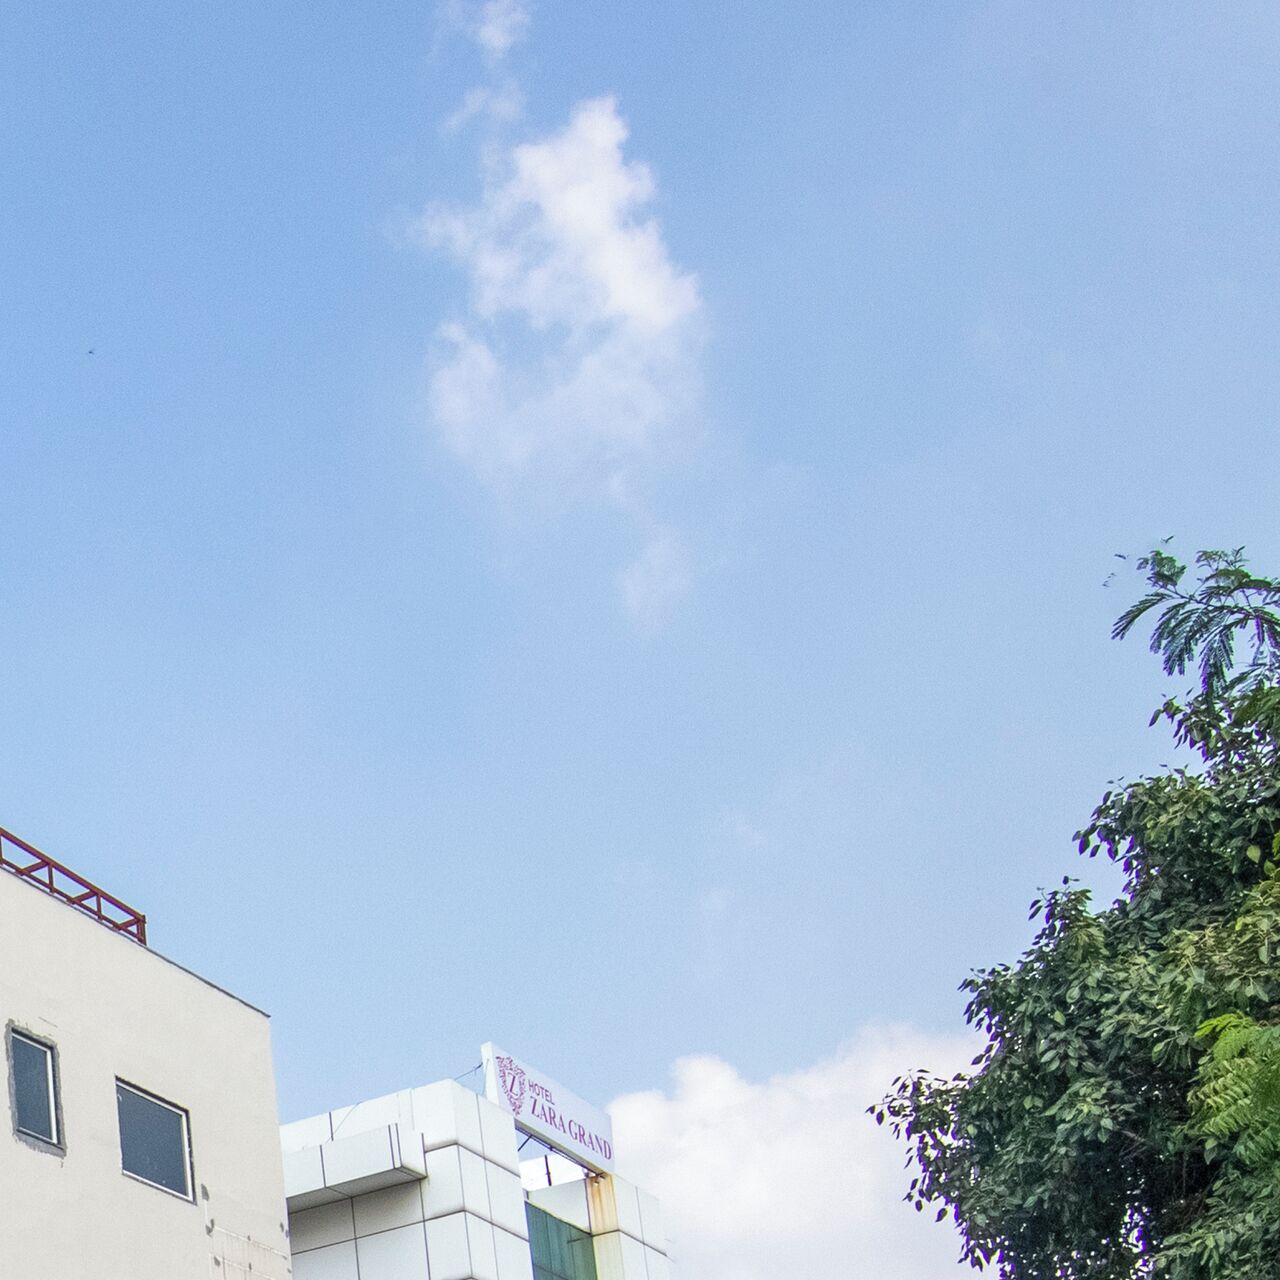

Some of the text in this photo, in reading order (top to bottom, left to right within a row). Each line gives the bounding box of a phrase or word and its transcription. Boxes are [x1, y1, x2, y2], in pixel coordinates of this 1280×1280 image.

[528, 1079, 555, 1105] HOTEL
[530, 1096, 612, 1161] ZARA GRAND
